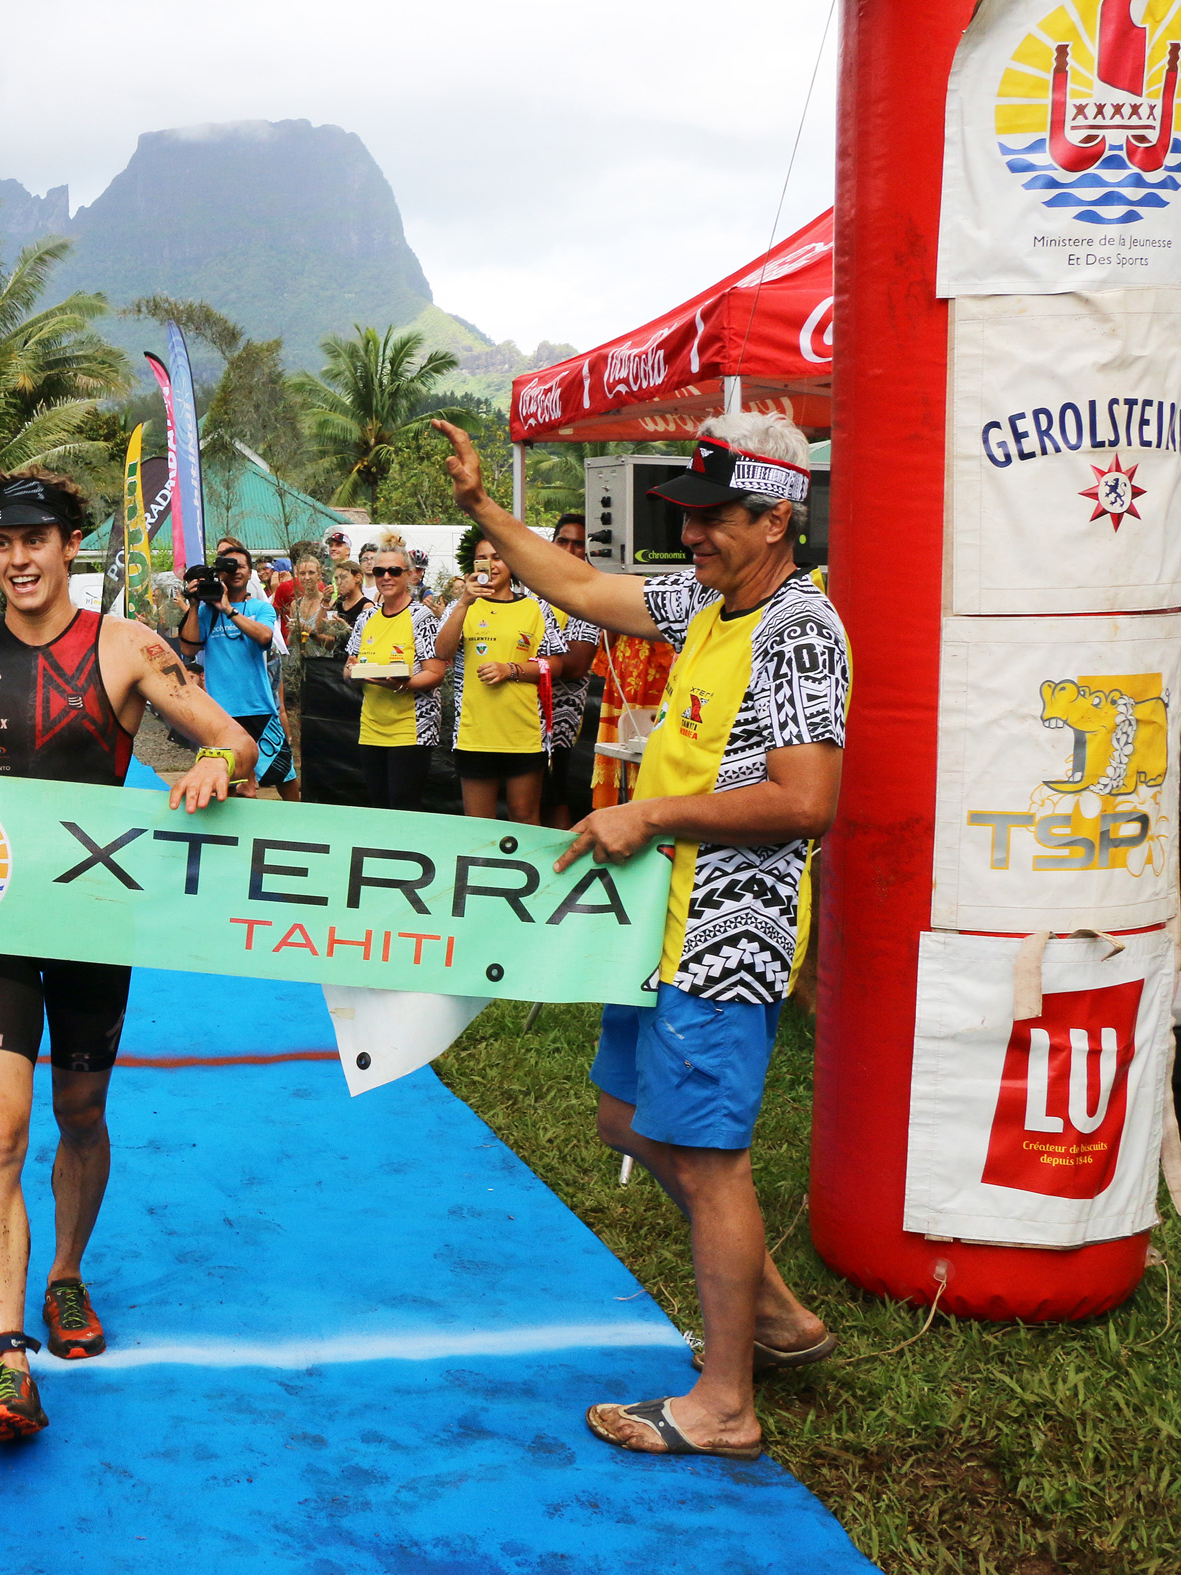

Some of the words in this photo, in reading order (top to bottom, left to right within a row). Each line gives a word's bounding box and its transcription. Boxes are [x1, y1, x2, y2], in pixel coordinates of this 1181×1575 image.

[1032, 235, 1094, 248] Ministere
[1098, 234, 1115, 246] de
[1118, 234, 1126, 247] la
[1127, 235, 1173, 250] Jeunesse
[1067, 253, 1081, 266] Et
[1085, 253, 1112, 266] Des
[1115, 252, 1149, 268] Sports
[648, 550, 686, 560] chronomix
[161, 663, 187, 687] 7
[967, 809, 1150, 872] TSP
[52, 820, 633, 926] XTERRA
[229, 916, 456, 968] TAHITI
[1024, 1027, 1118, 1134] LU
[1022, 1140, 1068, 1153] Créateur
[1080, 1141, 1108, 1153] biscuits
[1040, 1154, 1075, 1167] depuis
[1075, 1155, 1093, 1166] 1846
